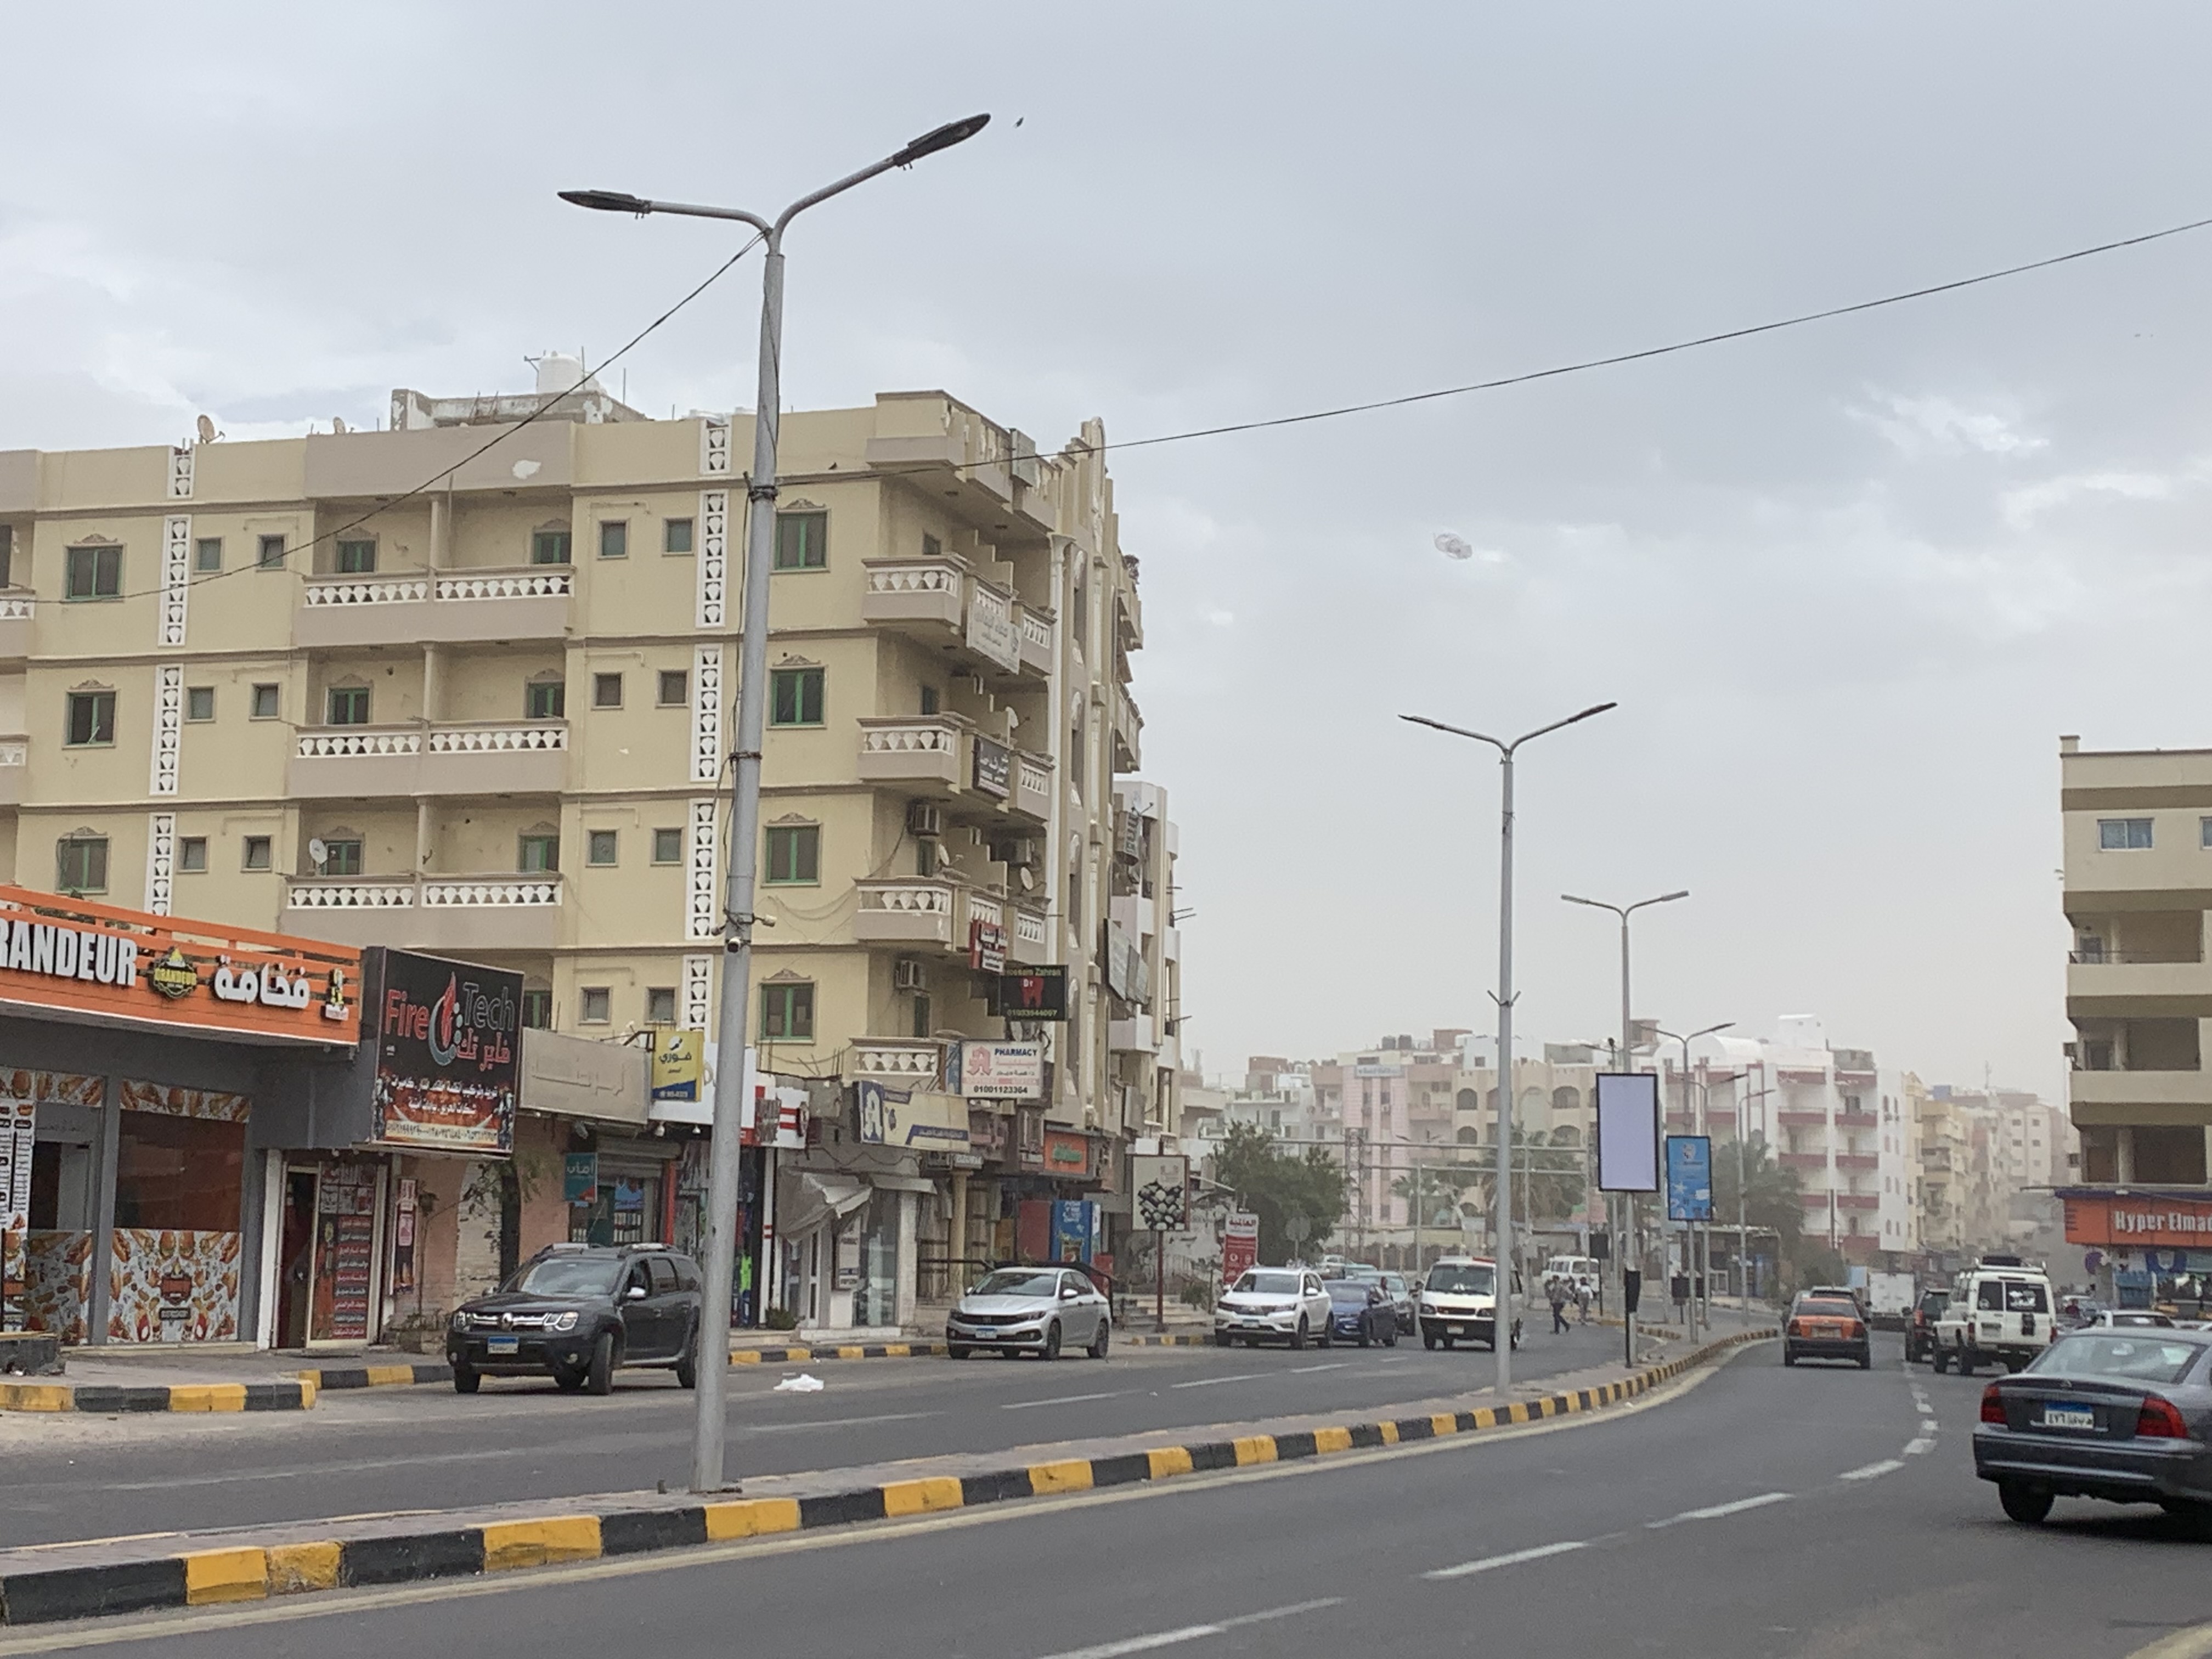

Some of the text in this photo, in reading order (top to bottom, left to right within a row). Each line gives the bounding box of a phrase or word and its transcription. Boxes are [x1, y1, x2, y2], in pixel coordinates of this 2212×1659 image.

[215, 955, 310, 1009] فخامة
[385, 981, 515, 1040] Fire Tech
[2115, 1210, 2165, 1233] Hyper
